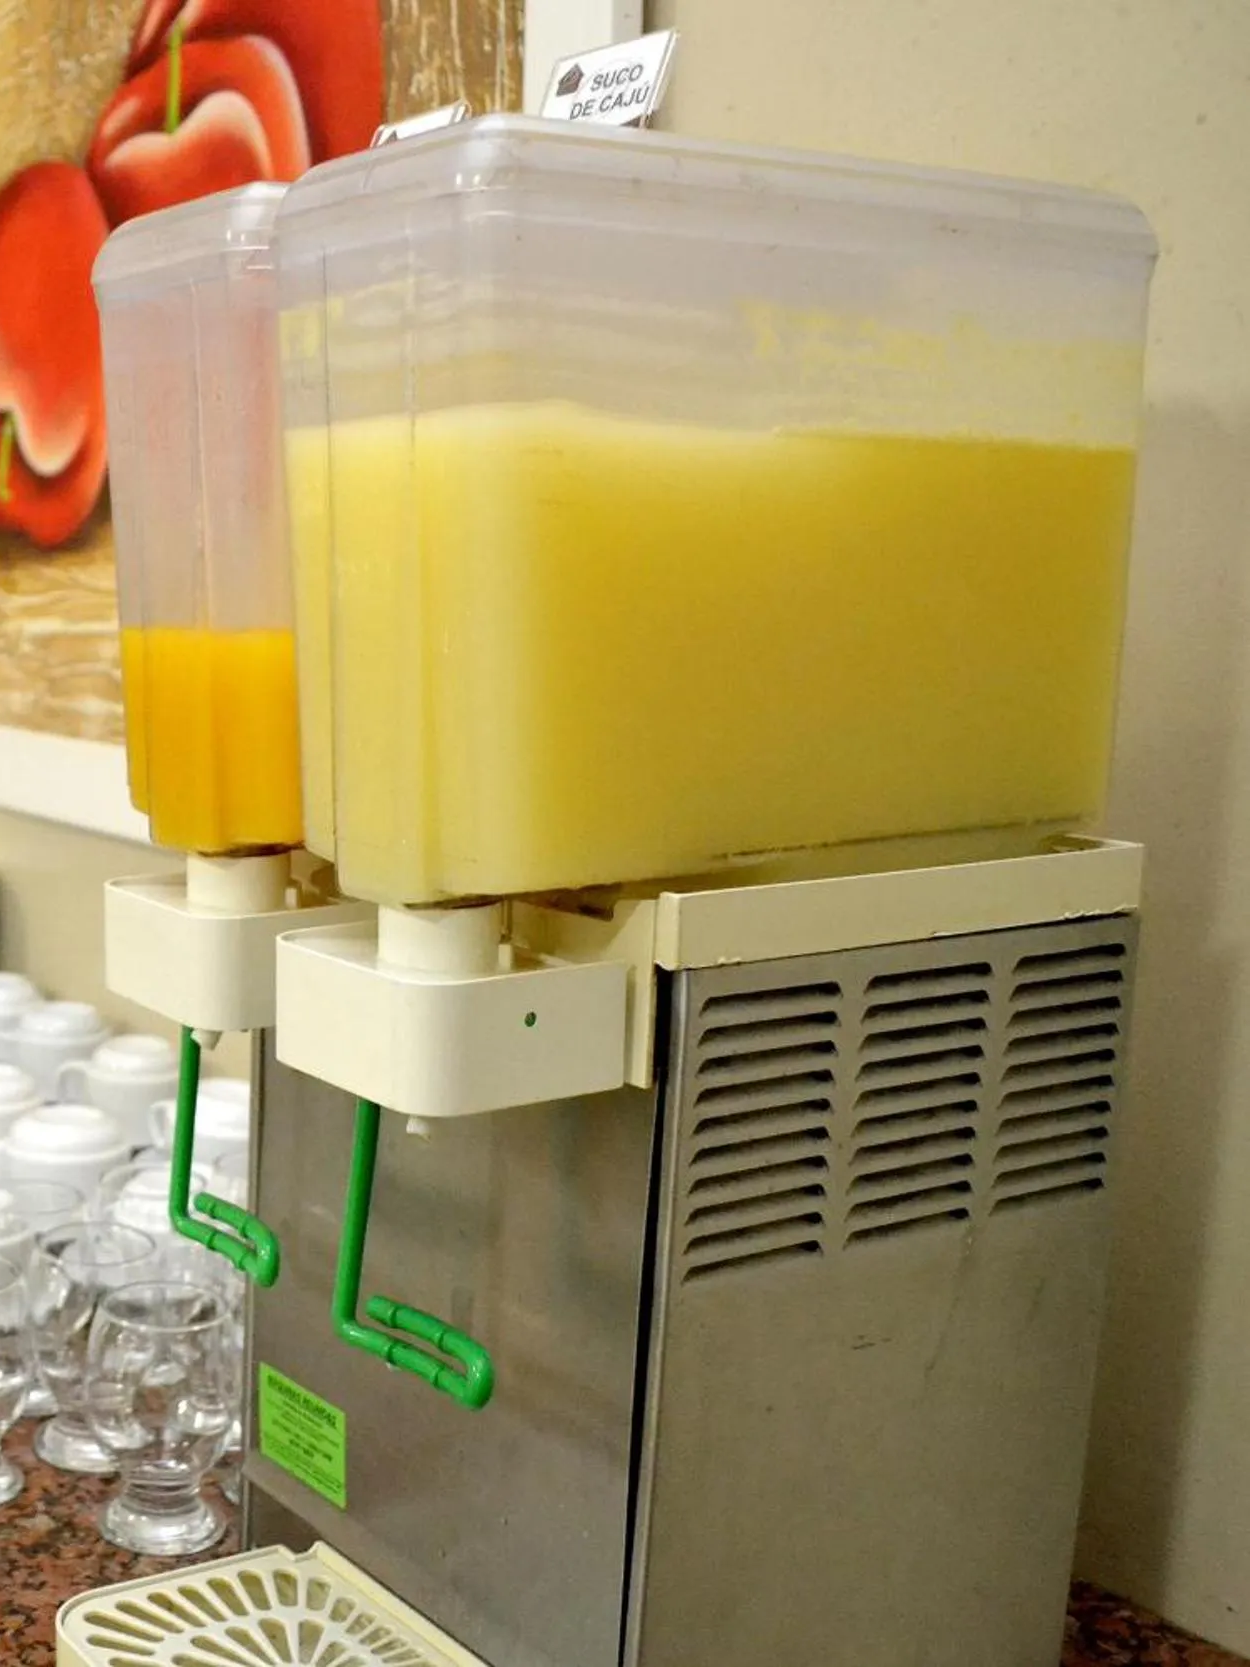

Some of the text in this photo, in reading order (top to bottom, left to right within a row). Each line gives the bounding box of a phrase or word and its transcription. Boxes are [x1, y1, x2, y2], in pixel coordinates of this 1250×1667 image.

[590, 64, 644, 91] SUCO
[569, 81, 650, 120] DE CAJÚ
